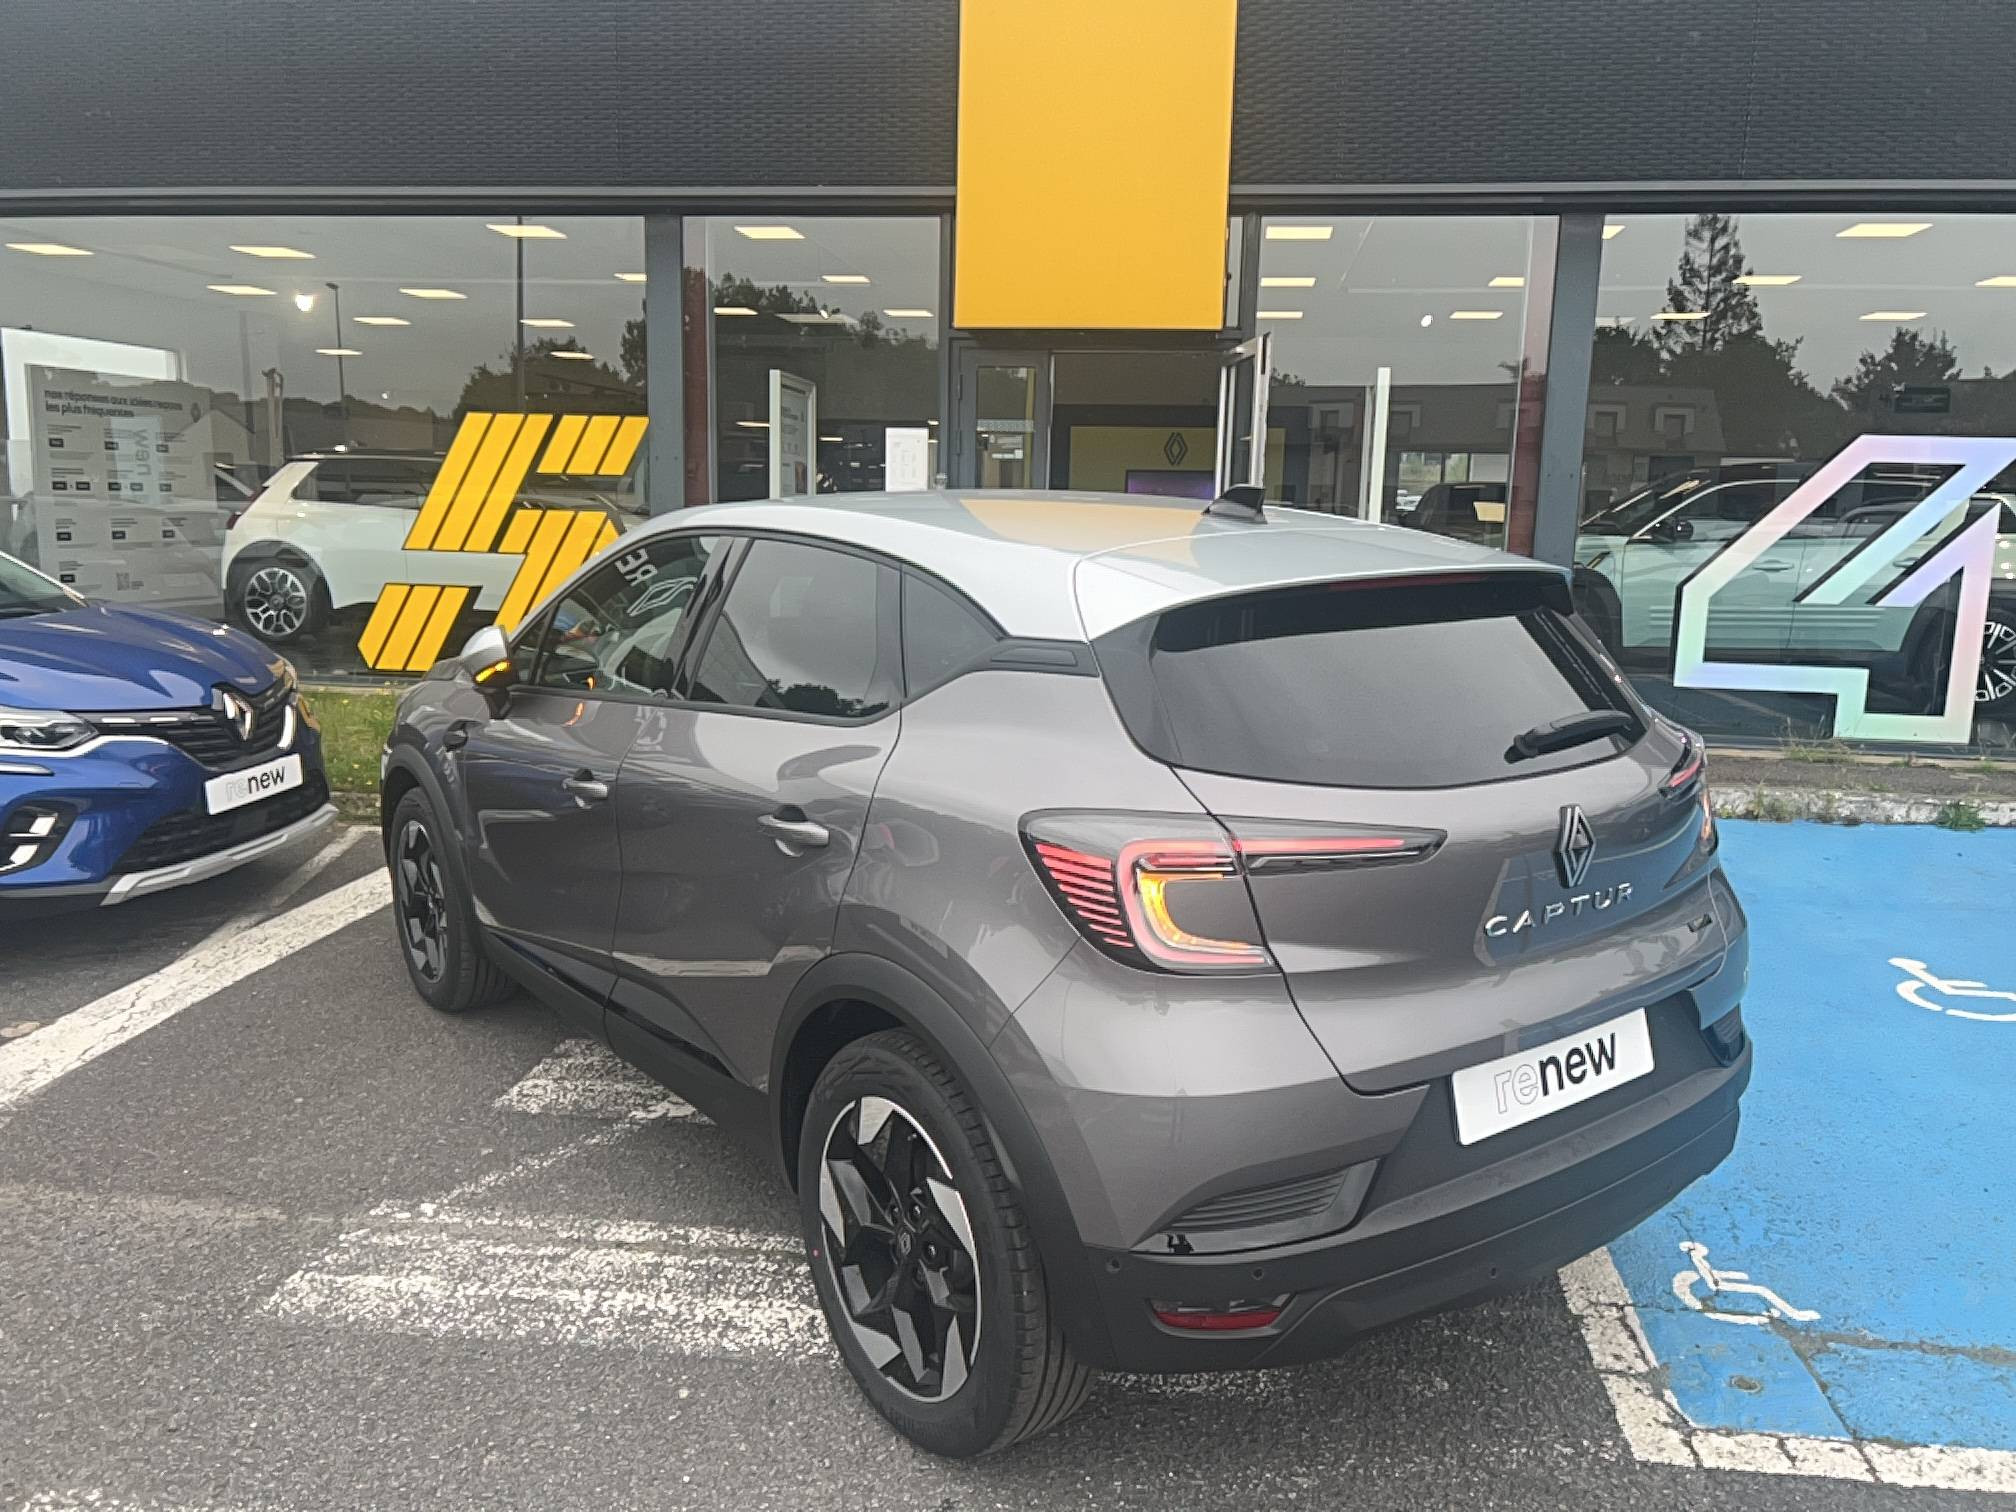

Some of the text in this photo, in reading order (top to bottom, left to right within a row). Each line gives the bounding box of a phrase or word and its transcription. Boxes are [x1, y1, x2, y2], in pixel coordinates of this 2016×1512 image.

[225, 765, 285, 803] renew
[1483, 882, 1633, 938] CAPTUR
[1494, 1032, 1617, 1115] renew
